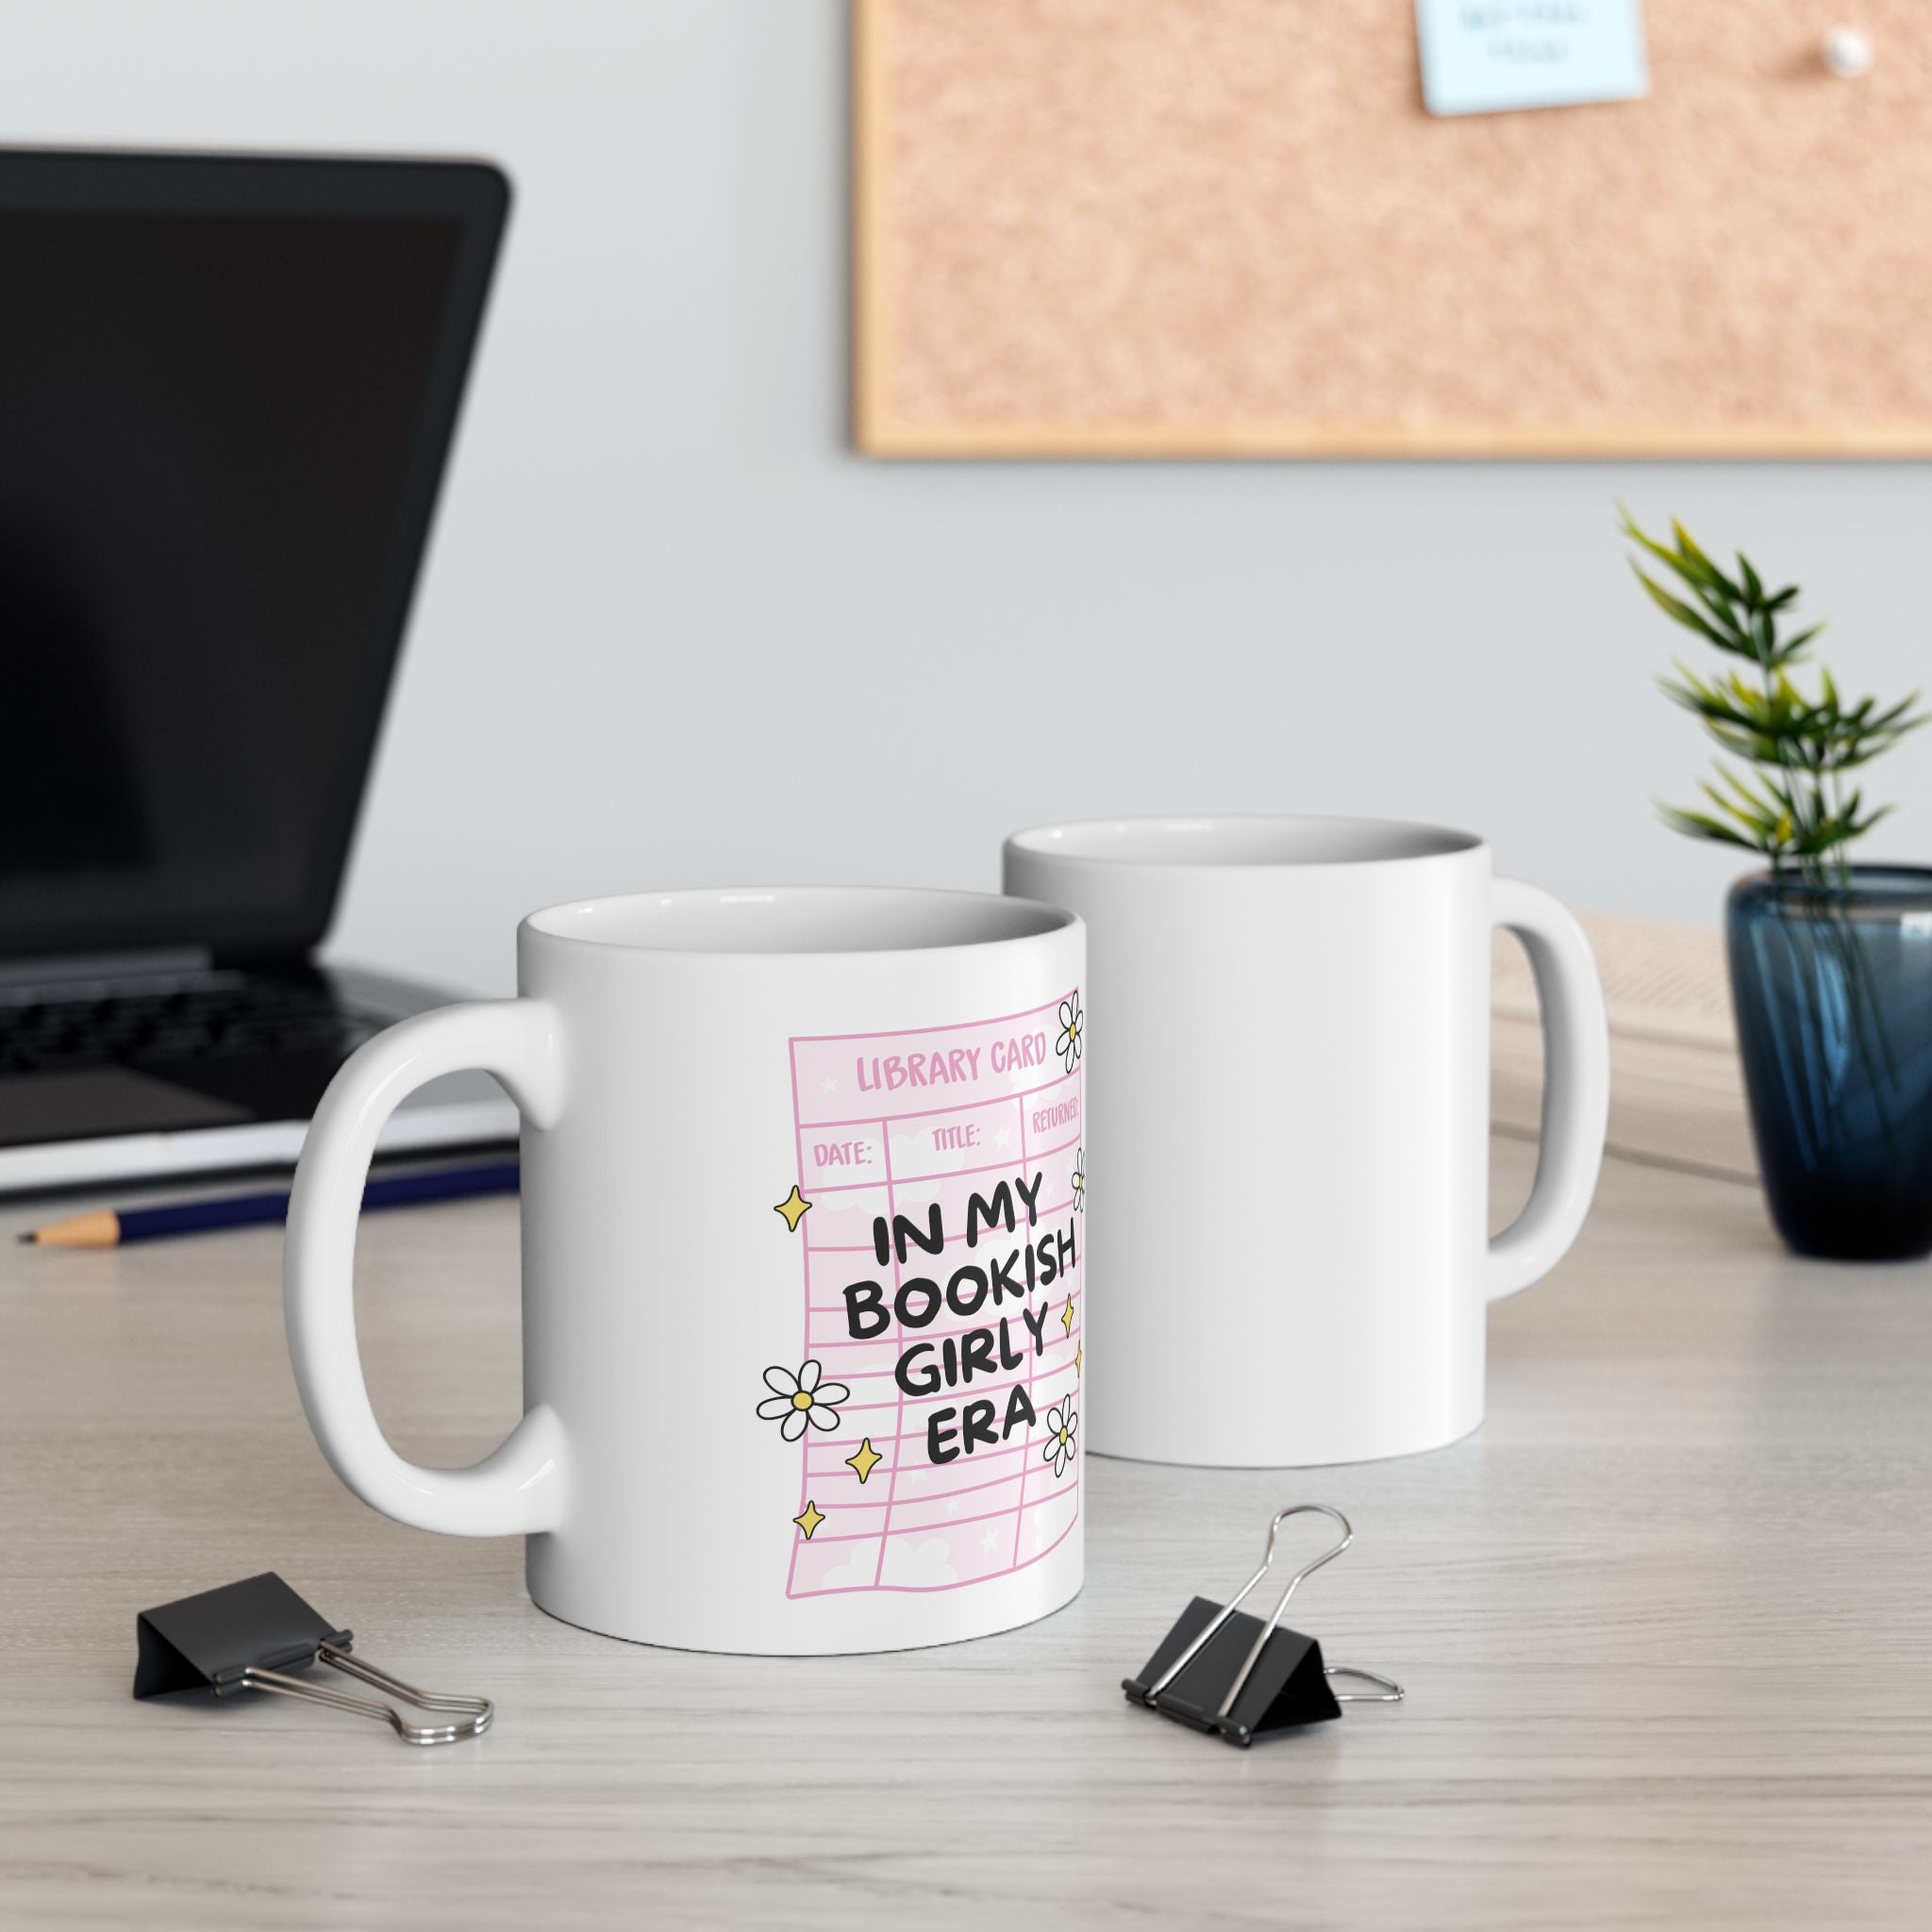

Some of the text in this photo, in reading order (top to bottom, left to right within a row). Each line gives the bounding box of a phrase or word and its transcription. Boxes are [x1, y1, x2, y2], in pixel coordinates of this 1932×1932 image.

[856, 1031, 1046, 1092] LIBRARY CARD
[932, 1124, 981, 1151] TITLE:
[1032, 1095, 1079, 1134] RETURNED:
[813, 1141, 873, 1167] DATE:
[873, 1171, 1042, 1266] IN MY
[842, 1216, 1076, 1340] BOOKISH
[894, 1301, 1048, 1396] GIRLY
[927, 1384, 1037, 1464] ERA
